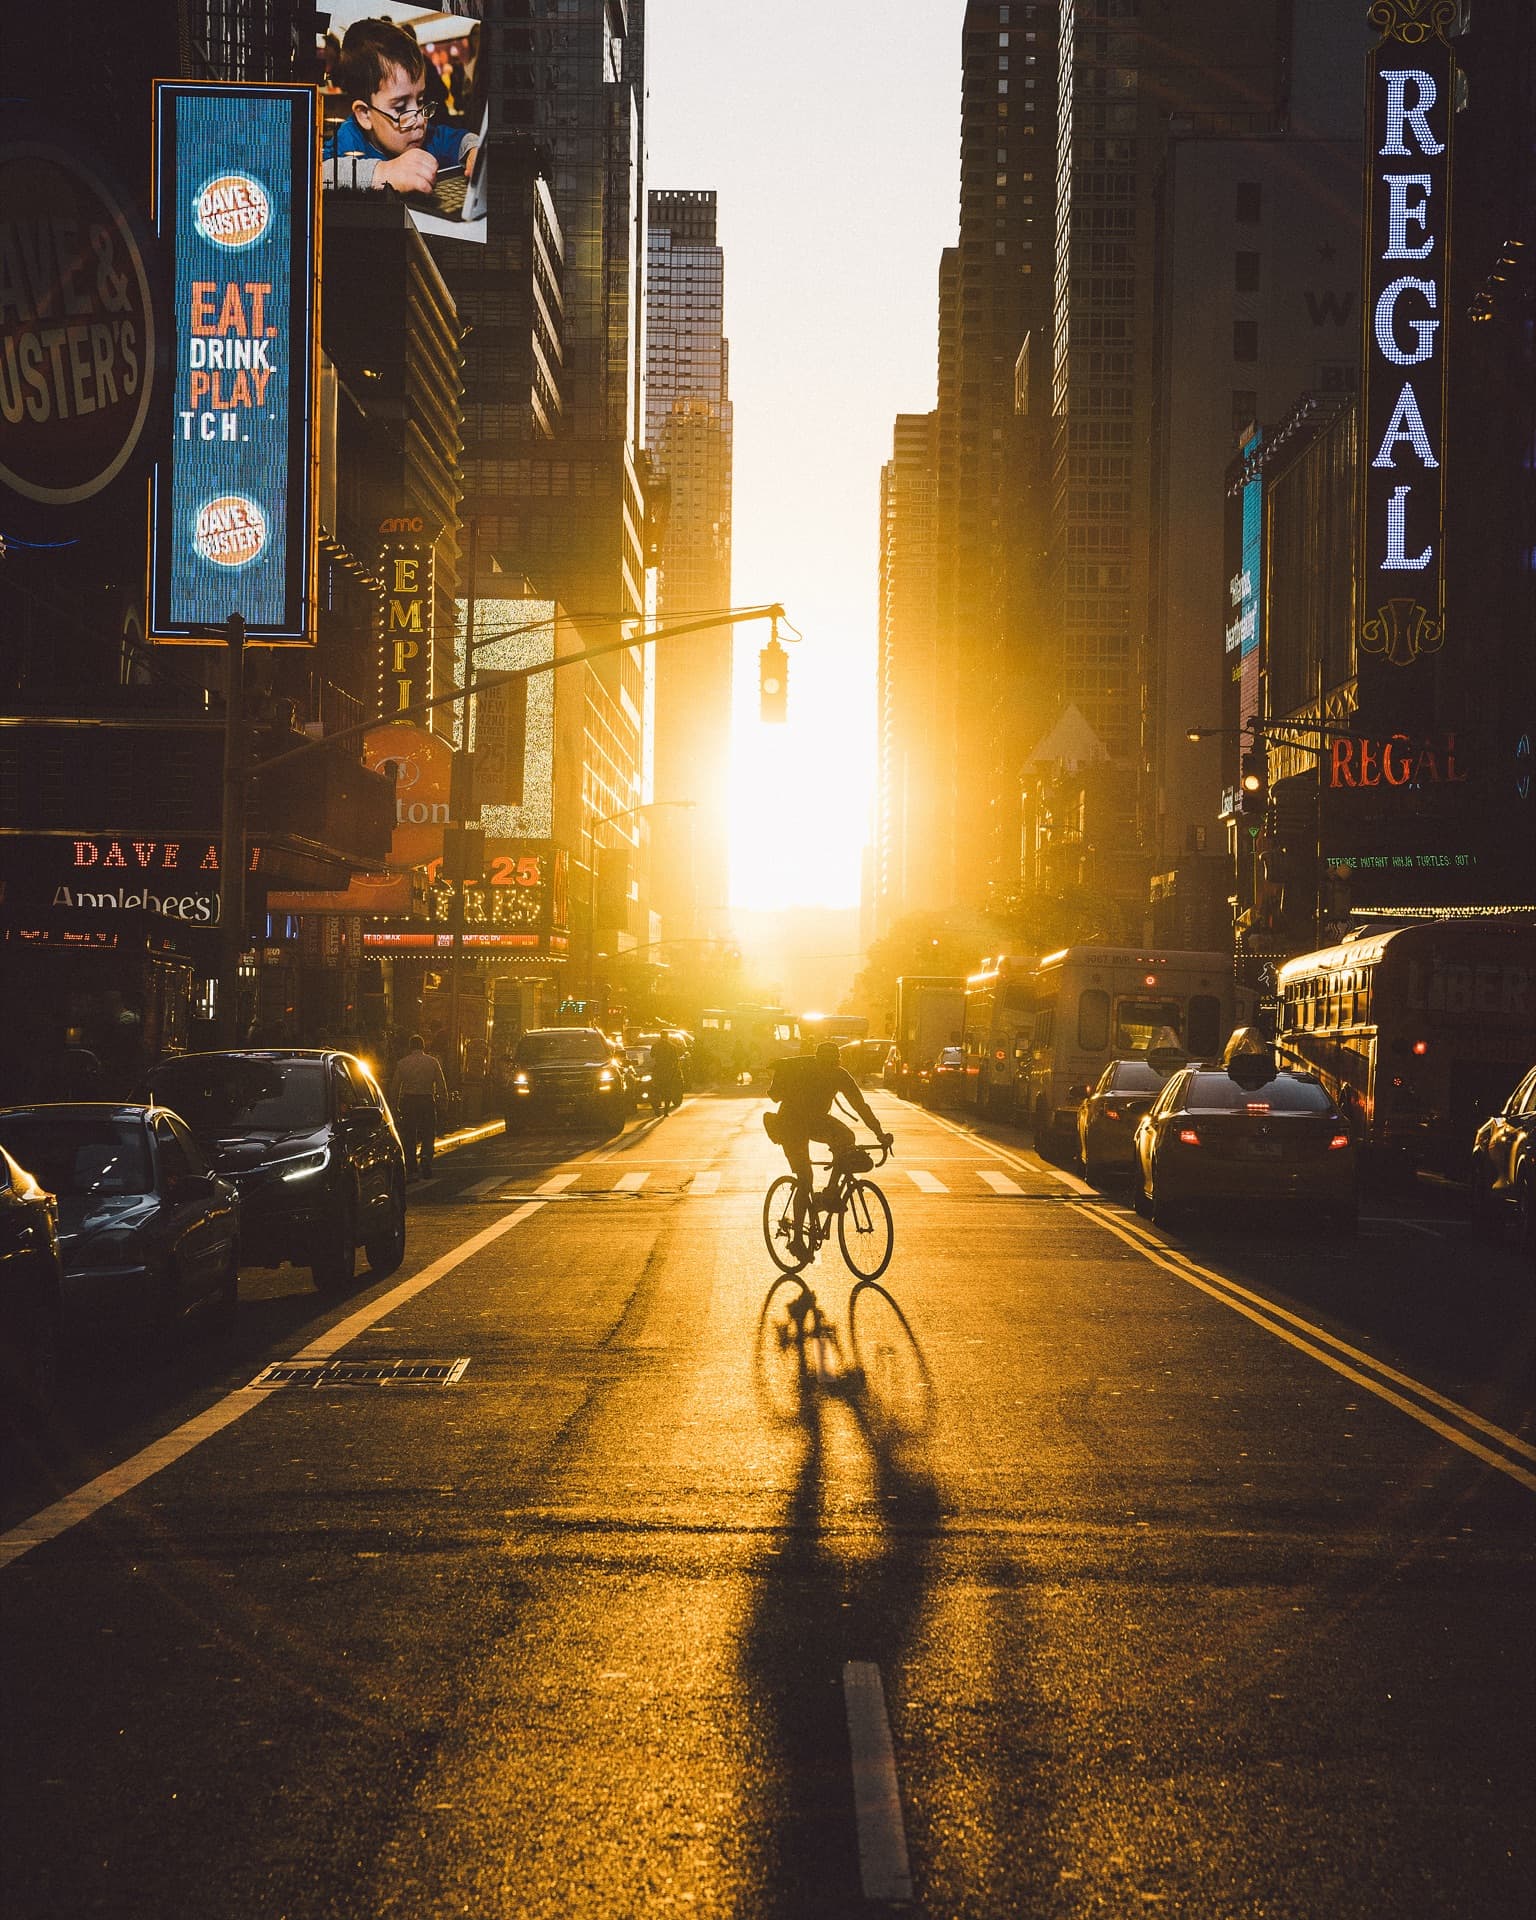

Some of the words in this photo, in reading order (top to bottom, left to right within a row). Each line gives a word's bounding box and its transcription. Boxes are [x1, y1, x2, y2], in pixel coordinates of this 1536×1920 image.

[200, 186, 249, 216] DAVE
[88, 222, 134, 313] &
[190, 280, 279, 338] EAT.
[1371, 68, 1447, 572] REGAL
[189, 337, 278, 373] DRINK.
[189, 367, 272, 410] PLAY
[172, 410, 250, 442] TCH.
[198, 505, 246, 537] DAVE
[388, 557, 426, 727] EMPI
[1328, 731, 1468, 789] REGAL
[395, 797, 450, 825] ton
[73, 840, 181, 869] DAVE
[490, 856, 542, 886] 25
